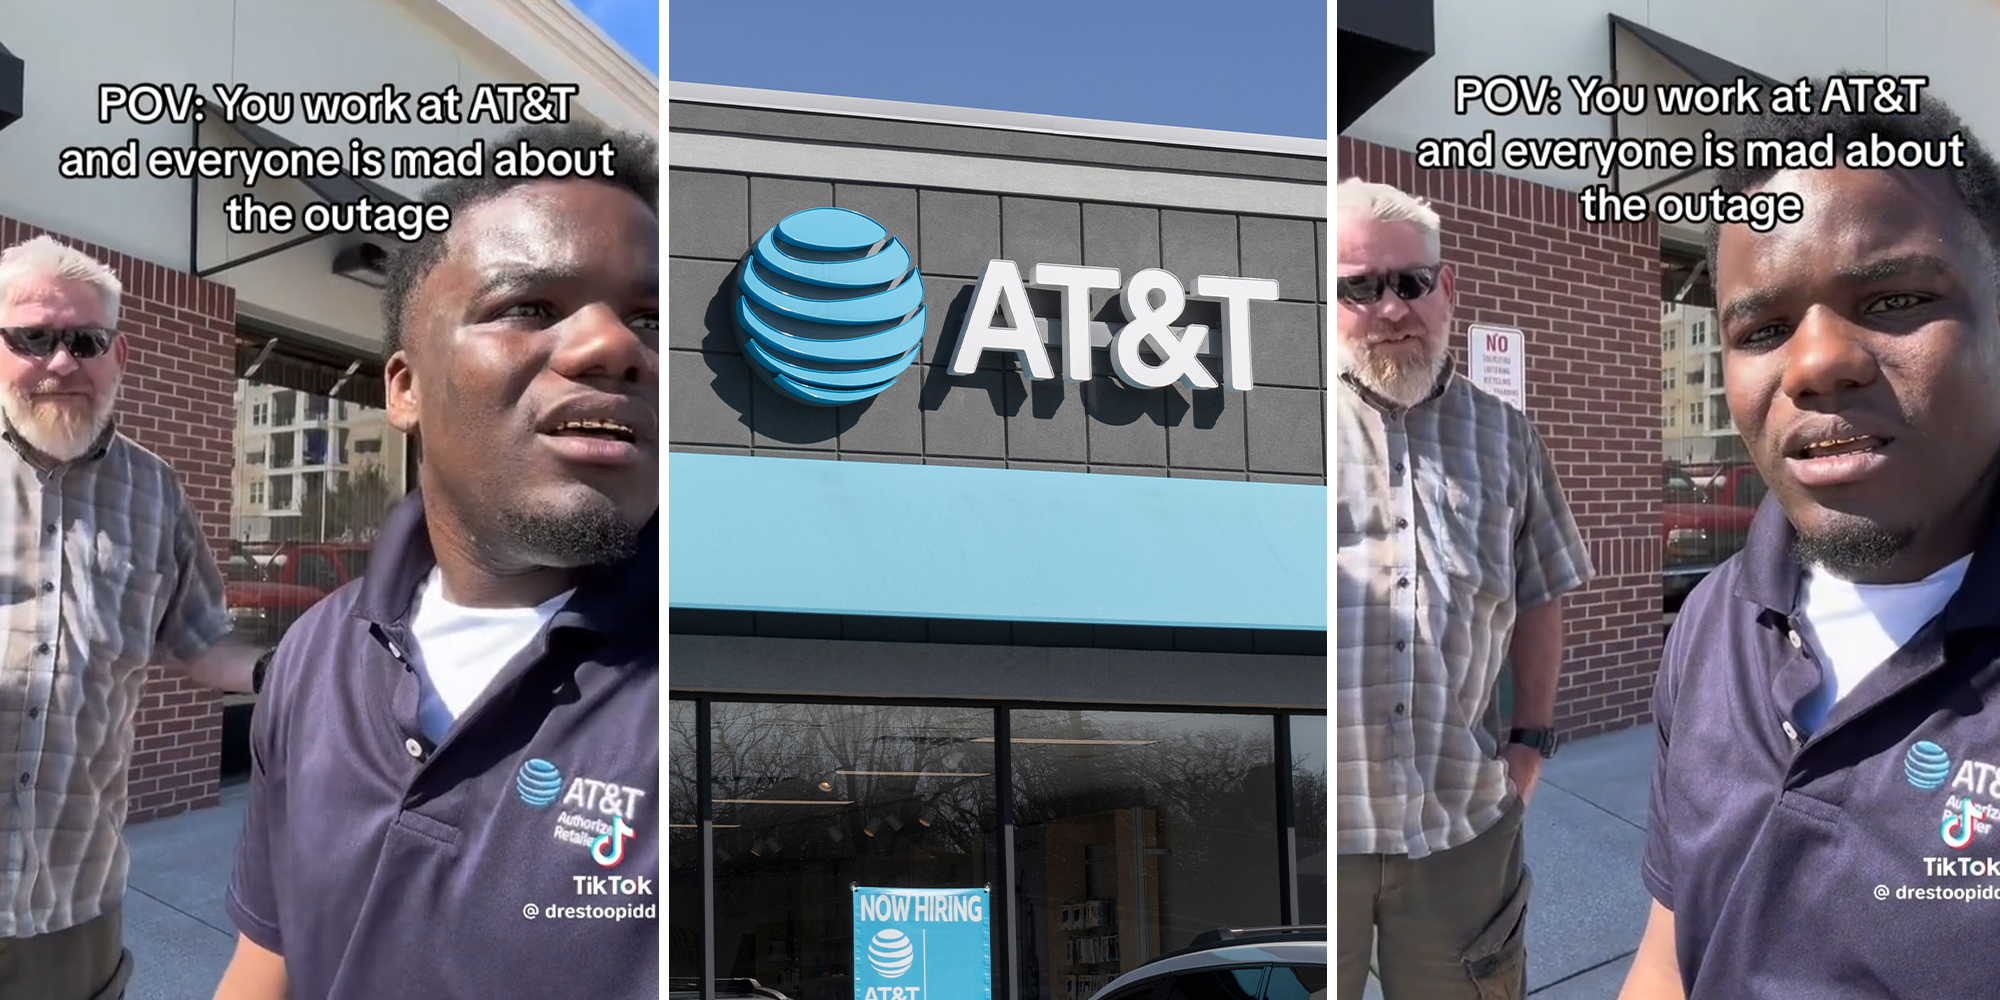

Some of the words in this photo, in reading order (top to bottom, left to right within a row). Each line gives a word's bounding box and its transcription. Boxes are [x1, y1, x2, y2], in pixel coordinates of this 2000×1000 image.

[947, 259, 1280, 392] AT&T
[1486, 333, 1509, 353] NO
[562, 777, 646, 820] AT&T
[860, 894, 911, 921] NOW
[915, 895, 982, 922] HIRING
[865, 986, 920, 1000] AT&T
